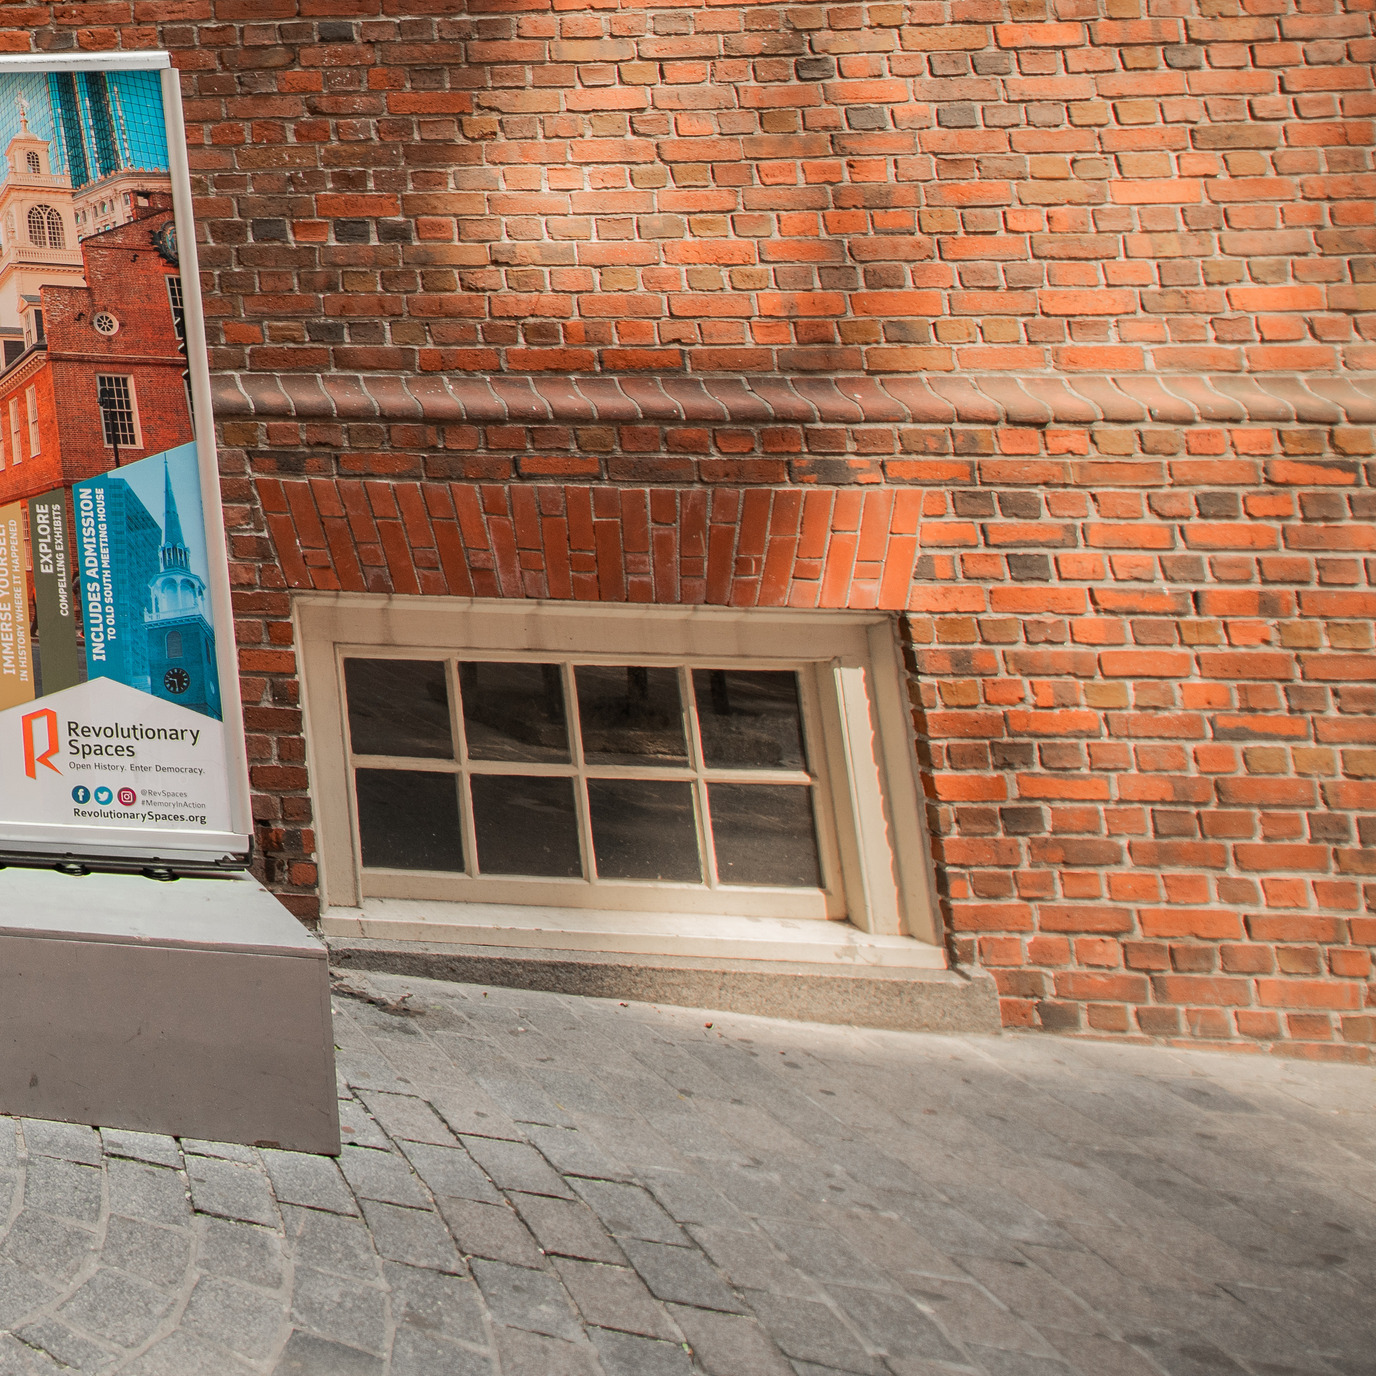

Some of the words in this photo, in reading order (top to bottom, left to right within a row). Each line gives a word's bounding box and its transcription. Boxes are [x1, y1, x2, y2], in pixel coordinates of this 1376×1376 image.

[95, 488, 106, 522] HOUSE
[36, 504, 54, 574] EXPLORE
[51, 504, 64, 550] EXHIBITS
[79, 488, 99, 579] ADMISSION
[8, 520, 21, 573] HAPPENED
[98, 523, 110, 568] MEETING
[13, 574, 21, 585] IT
[55, 551, 69, 617] COMPELLING
[101, 570, 114, 604] SOUTH
[13, 586, 23, 623] WHERE
[87, 582, 106, 661] INCLUDES
[105, 605, 115, 626] OLD
[0, 602, 16, 674] IMMERSE
[15, 625, 27, 669] HISTORY
[108, 628, 116, 641] TO
[19, 670, 28, 682] IN
[67, 721, 200, 746] Revolutionary
[68, 740, 136, 759] Spaces
[68, 761, 92, 771] Open
[94, 762, 127, 772] History.
[130, 763, 152, 772] Enter
[155, 765, 205, 774] Democracy.
[141, 789, 188, 798] @RevSpaces
[141, 800, 206, 809] #MemoryInAction
[73, 808, 207, 825] RevolutionarySpaces.org
